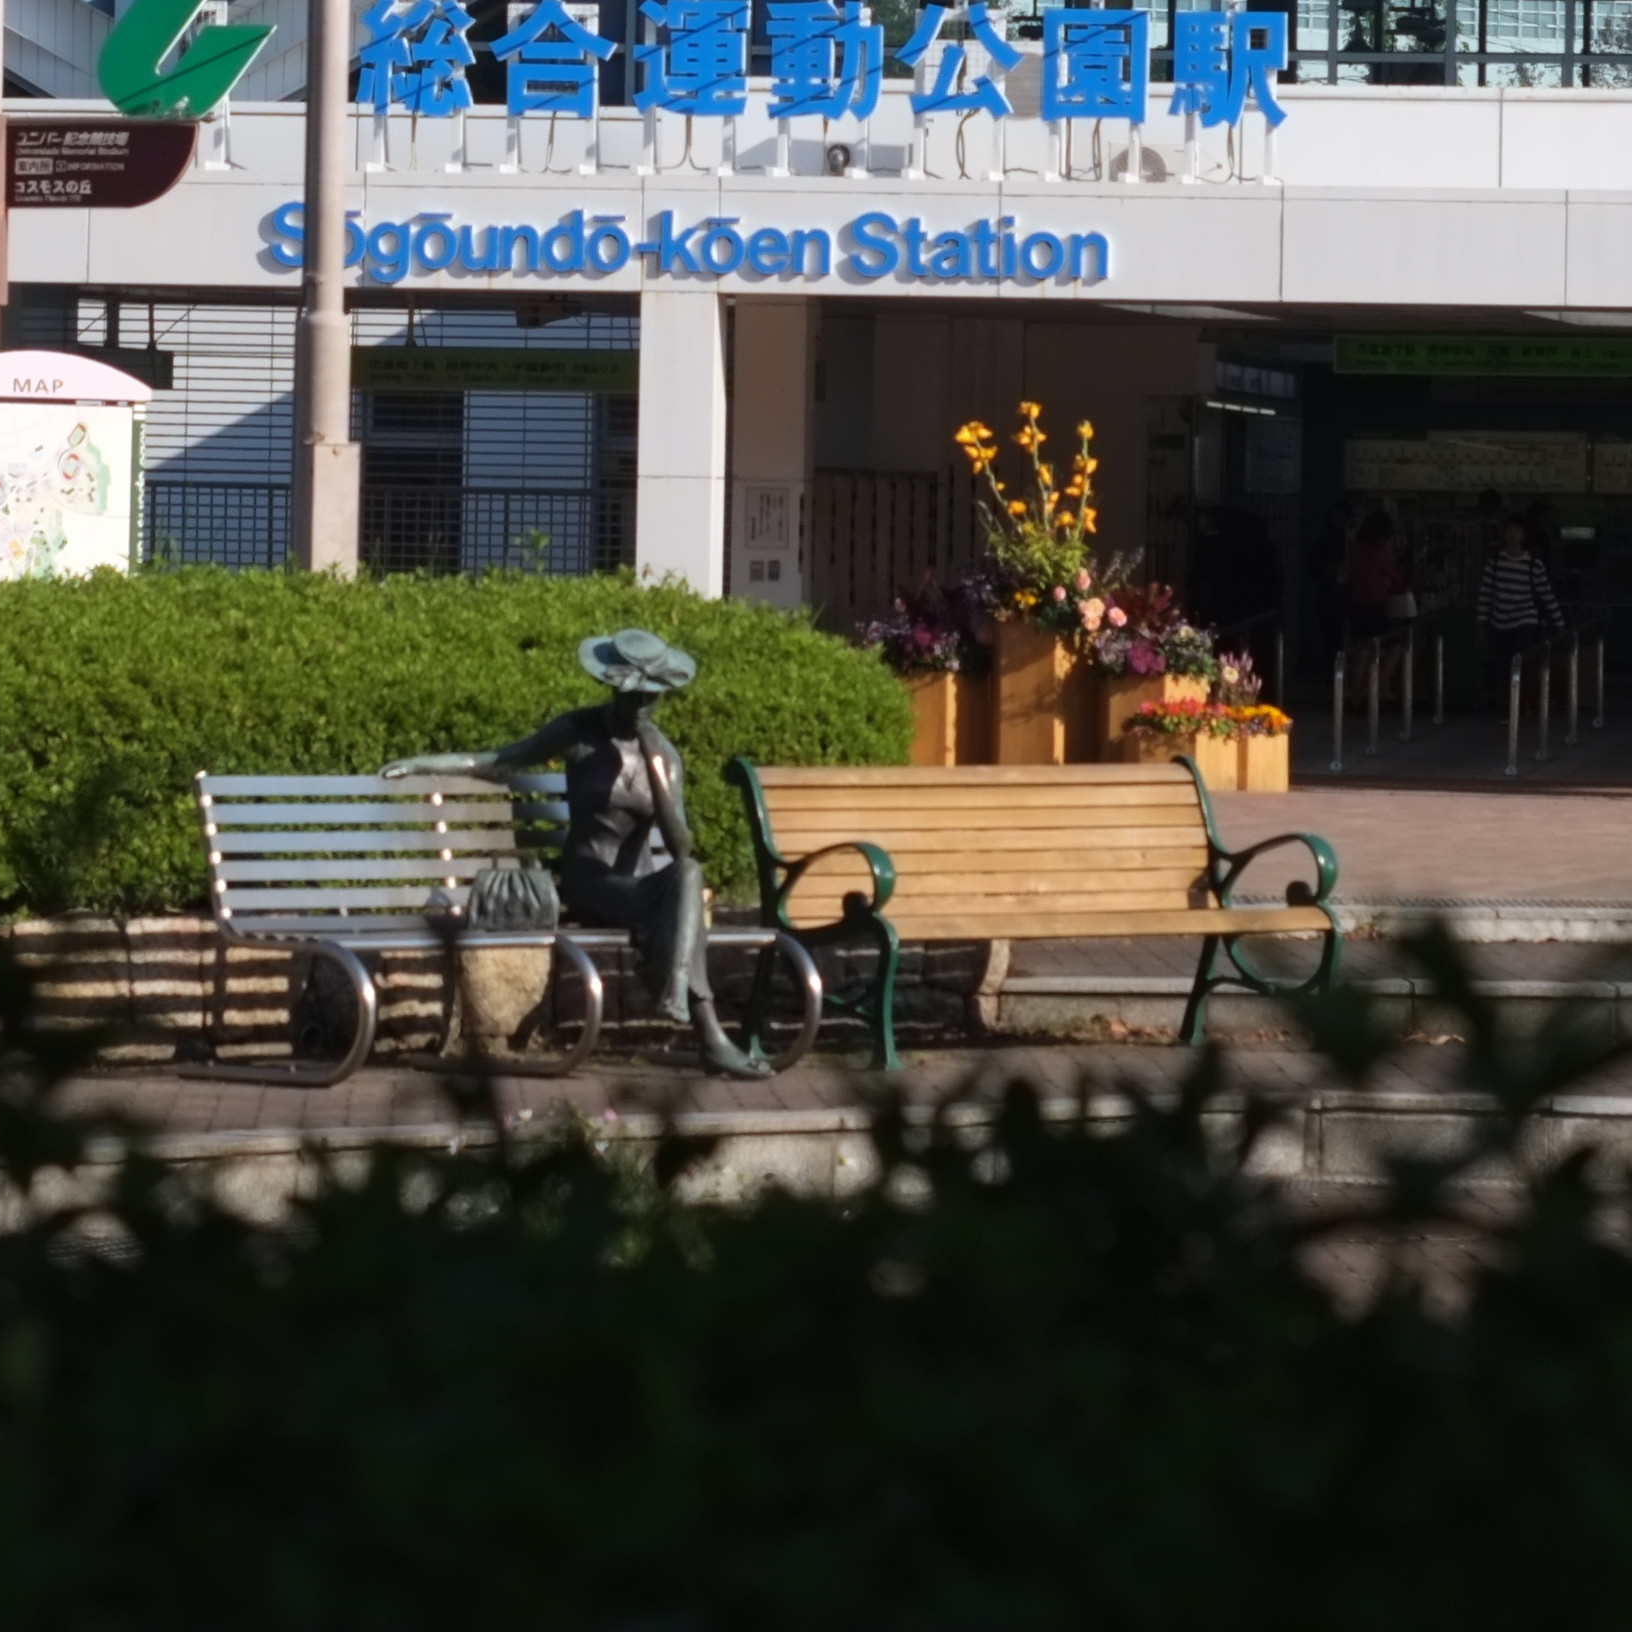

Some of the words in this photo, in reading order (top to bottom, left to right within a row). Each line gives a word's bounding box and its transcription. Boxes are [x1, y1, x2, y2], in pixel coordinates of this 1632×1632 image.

[15, 179, 92, 195] コスモスの丘
[851, 211, 1109, 280] Station
[13, 378, 64, 394] MAP
